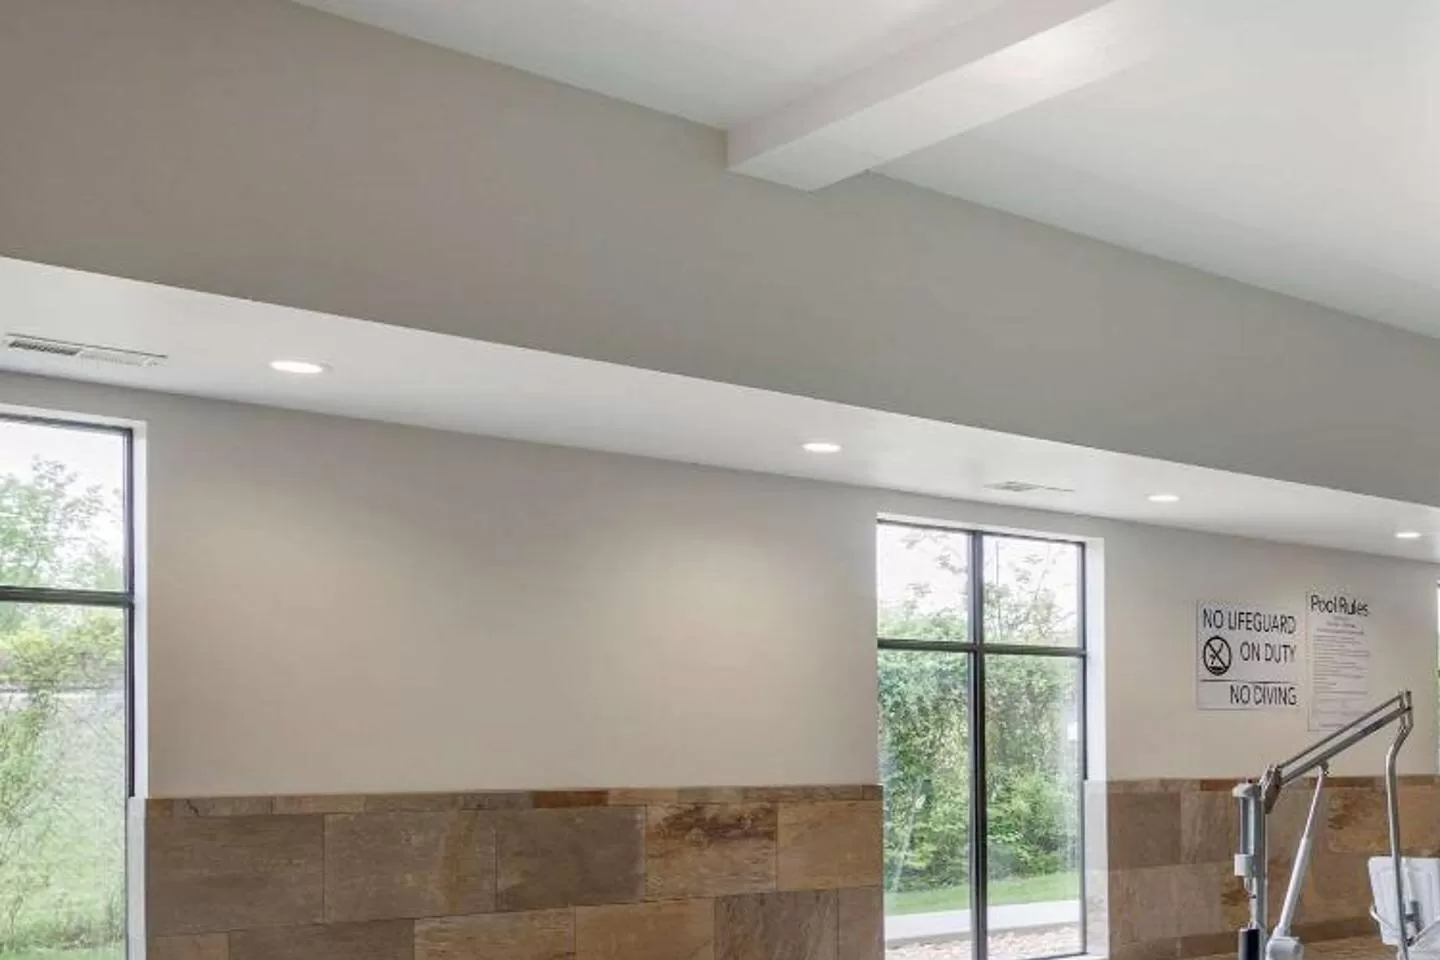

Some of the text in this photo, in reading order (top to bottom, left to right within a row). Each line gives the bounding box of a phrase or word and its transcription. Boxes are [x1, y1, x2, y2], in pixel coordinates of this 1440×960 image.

[1310, 594, 1369, 615] Pool Rules
[1202, 608, 1297, 634] NO LIFEGUARD
[1240, 641, 1297, 663] ON DUTY
[1229, 684, 1298, 706] NO DIVING
